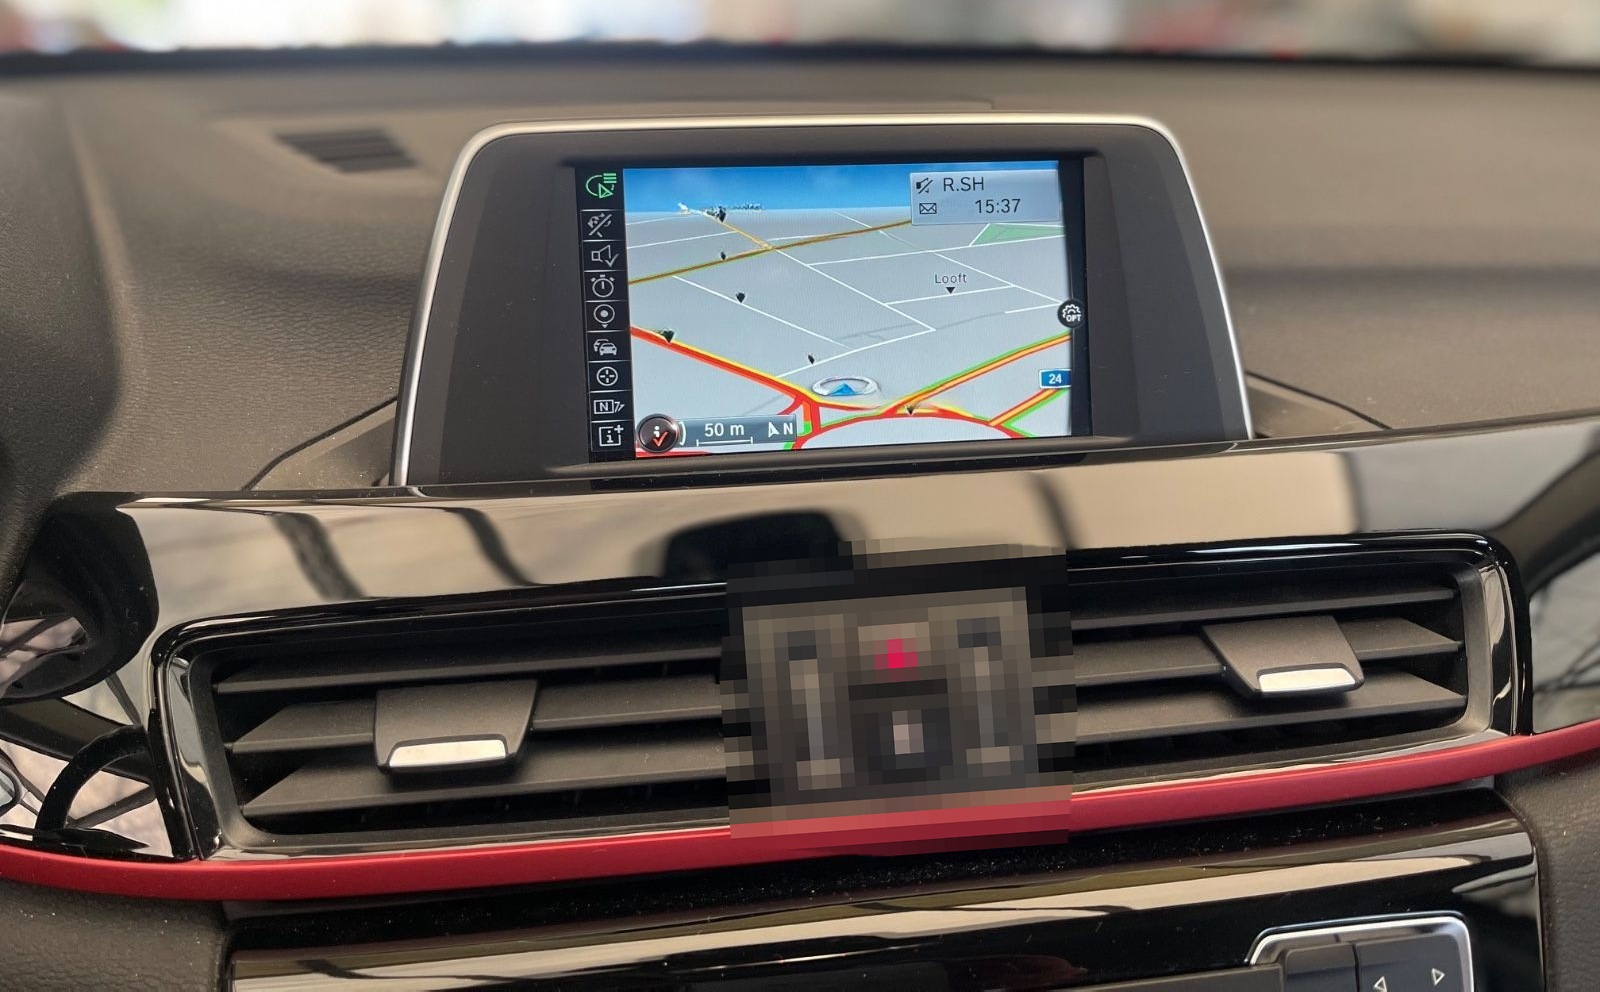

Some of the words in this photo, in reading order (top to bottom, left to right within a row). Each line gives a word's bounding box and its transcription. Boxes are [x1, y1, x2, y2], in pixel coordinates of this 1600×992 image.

[943, 176, 985, 192] R.SH
[975, 198, 1021, 214] 15:37
[934, 272, 968, 284] Looft
[1065, 313, 1082, 323] OPT
[1048, 374, 1063, 384] 24
[704, 422, 725, 437] 50
[729, 423, 745, 436] m
[783, 422, 794, 435] N
